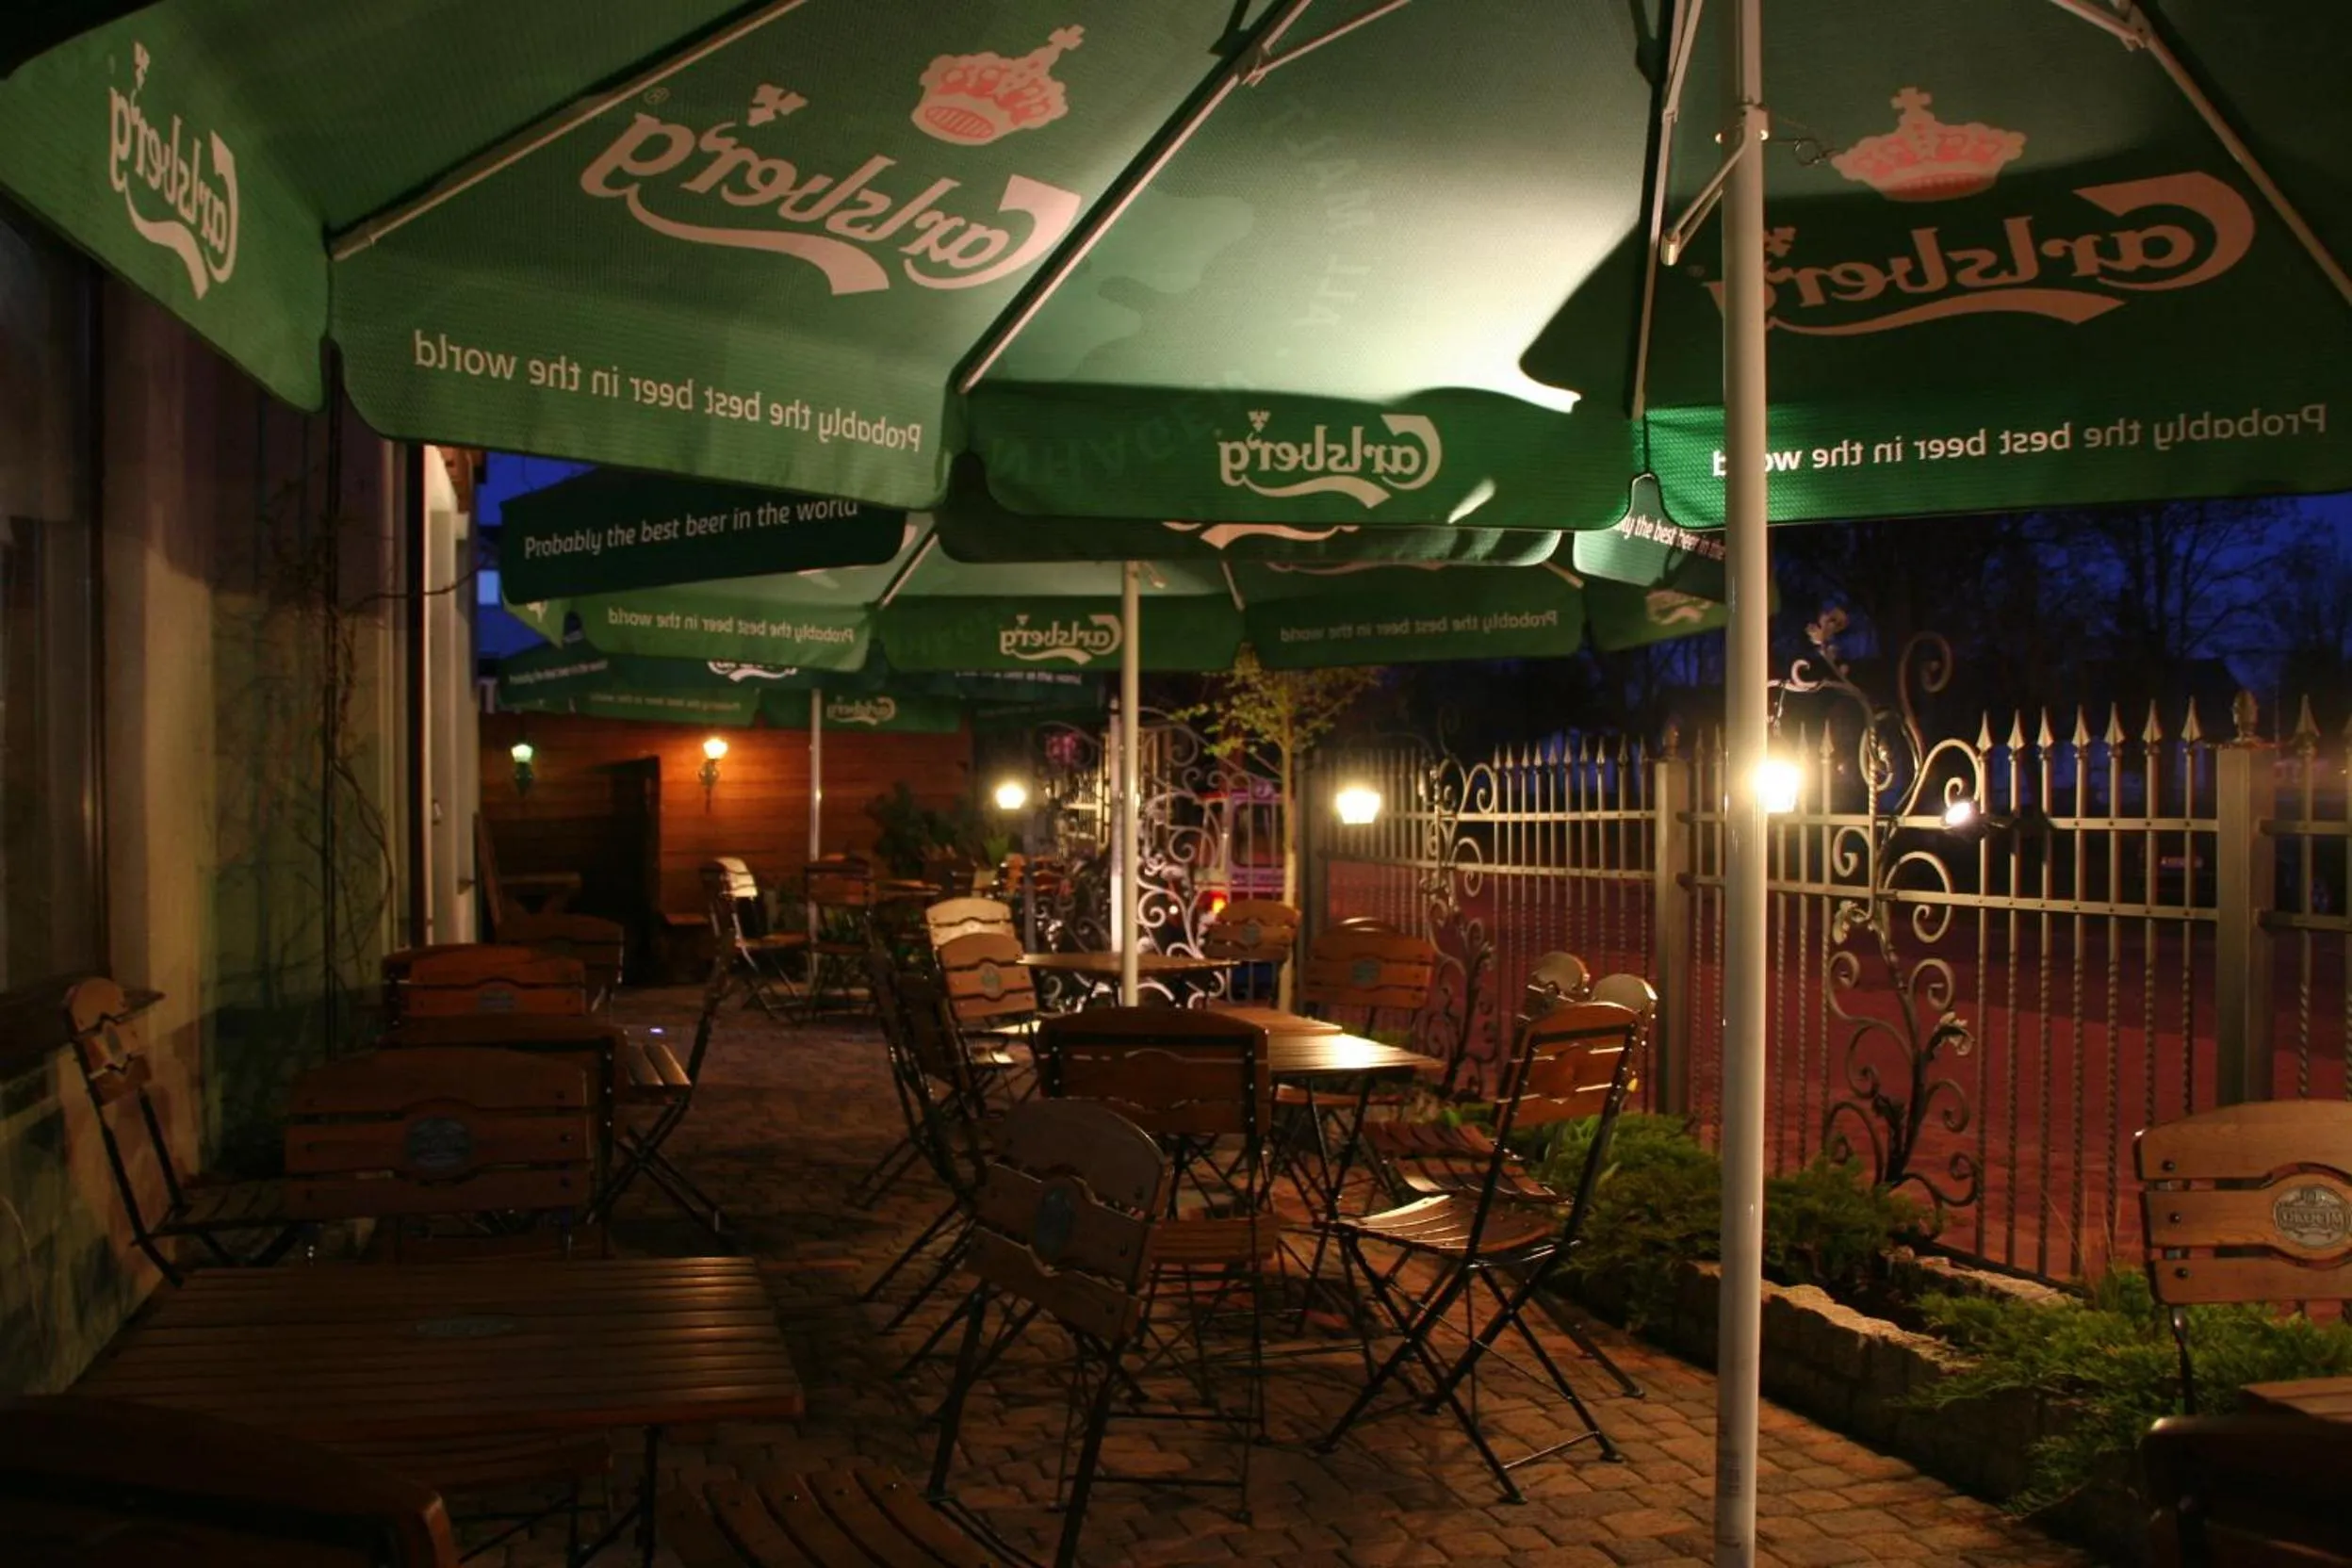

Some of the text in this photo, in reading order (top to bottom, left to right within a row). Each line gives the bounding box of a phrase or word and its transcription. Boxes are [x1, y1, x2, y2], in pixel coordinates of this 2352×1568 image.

[524, 528, 603, 560] Probably
[607, 523, 636, 548] the
[641, 519, 679, 543] best
[685, 513, 727, 537] beer
[733, 507, 751, 531] in
[757, 501, 791, 527] the
[1634, 514, 1654, 539] the
[1653, 518, 1677, 546] best
